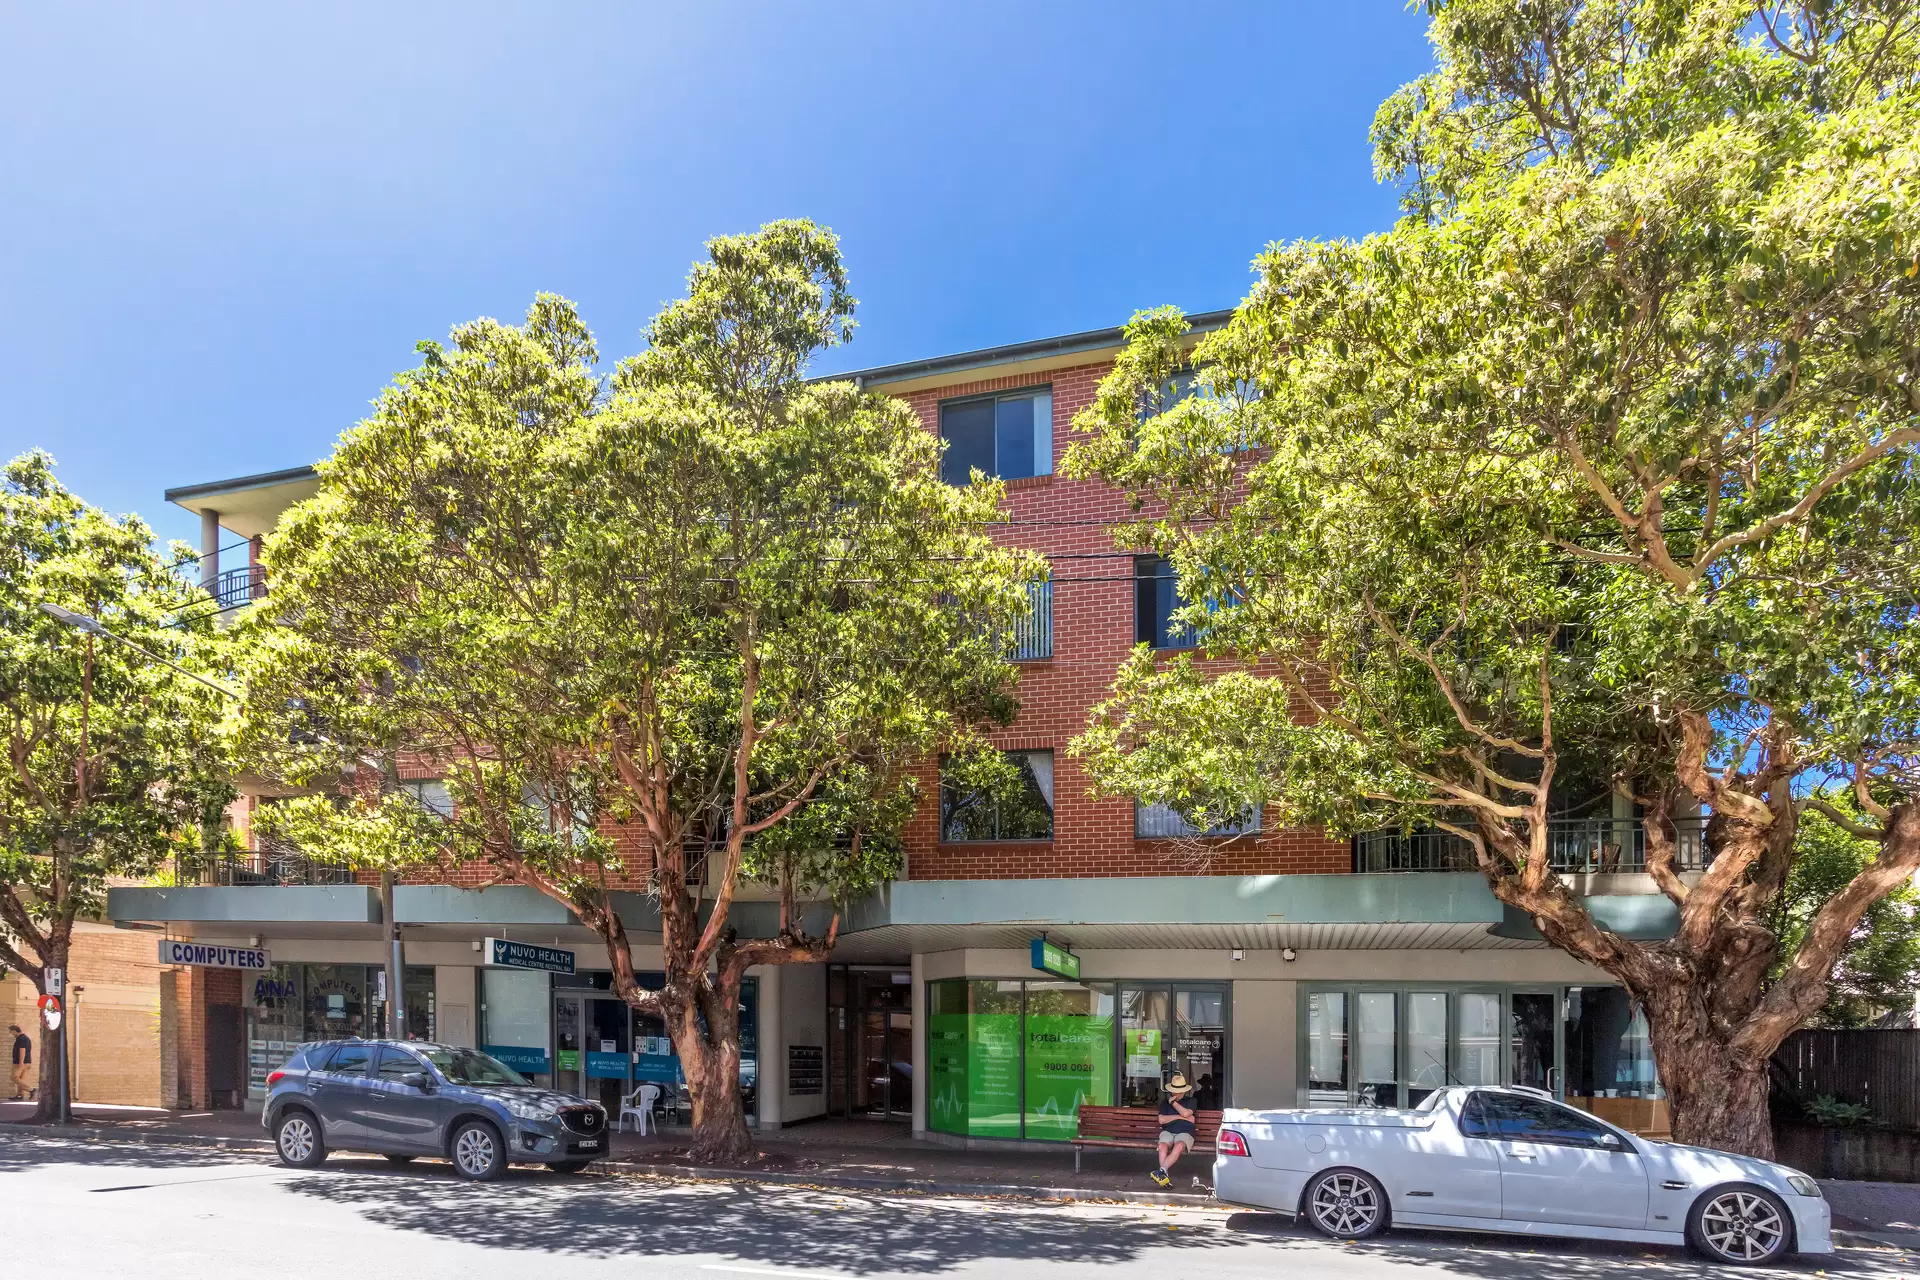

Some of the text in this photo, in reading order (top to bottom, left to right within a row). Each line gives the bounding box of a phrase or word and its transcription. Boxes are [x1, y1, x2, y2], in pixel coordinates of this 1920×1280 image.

[172, 944, 265, 968] COMPUTERS
[510, 946, 571, 965] NUVO HEALTH
[508, 958, 528, 967] MEDICAL
[528, 960, 545, 969] CENTRE
[545, 963, 563, 972] NEUTRAL
[254, 979, 297, 997] ANA
[589, 977, 594, 985] 3
[307, 979, 362, 1001] COMPUTERS
[1030, 1032, 1091, 1042] totalcare
[518, 1056, 544, 1064] HEALTH
[1044, 1063, 1095, 1072] 9909 0020
